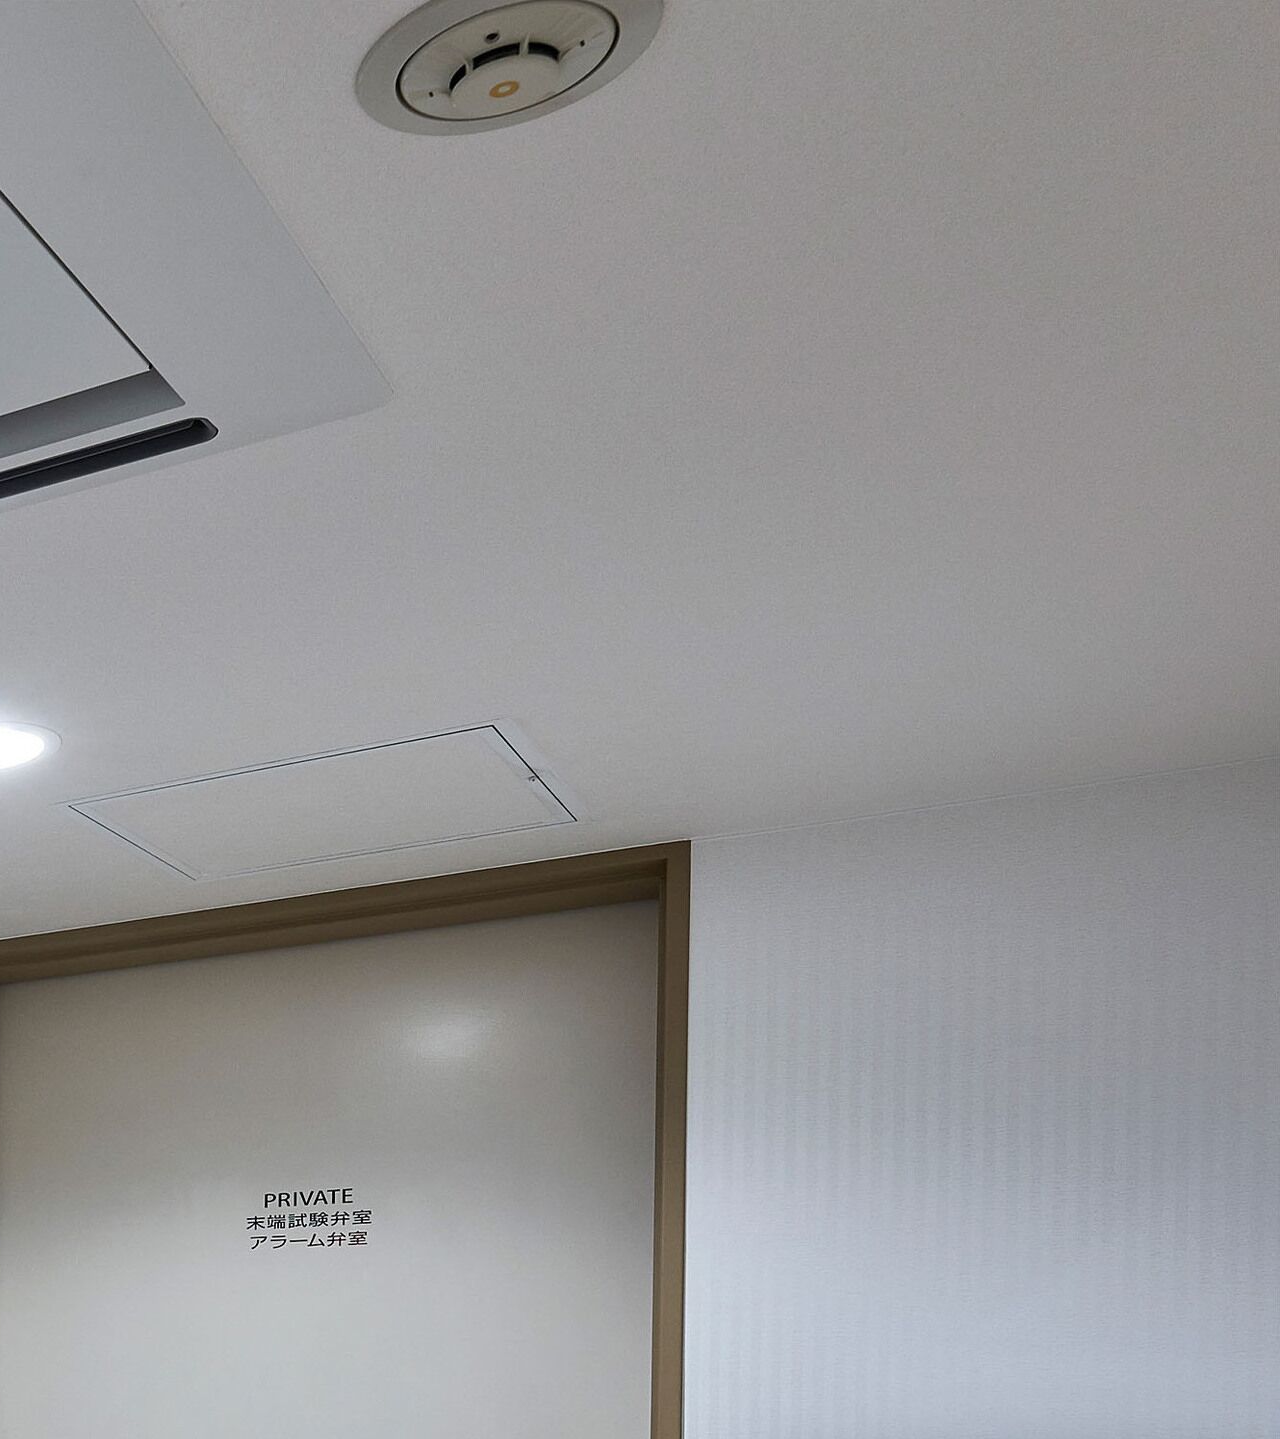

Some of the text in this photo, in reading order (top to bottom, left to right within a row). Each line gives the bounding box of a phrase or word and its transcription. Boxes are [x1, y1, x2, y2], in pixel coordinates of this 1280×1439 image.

[263, 1188, 354, 1208] PRIVATE
[246, 1210, 372, 1230] 末端試験弁室
[250, 1231, 368, 1249] アラーム弁室
